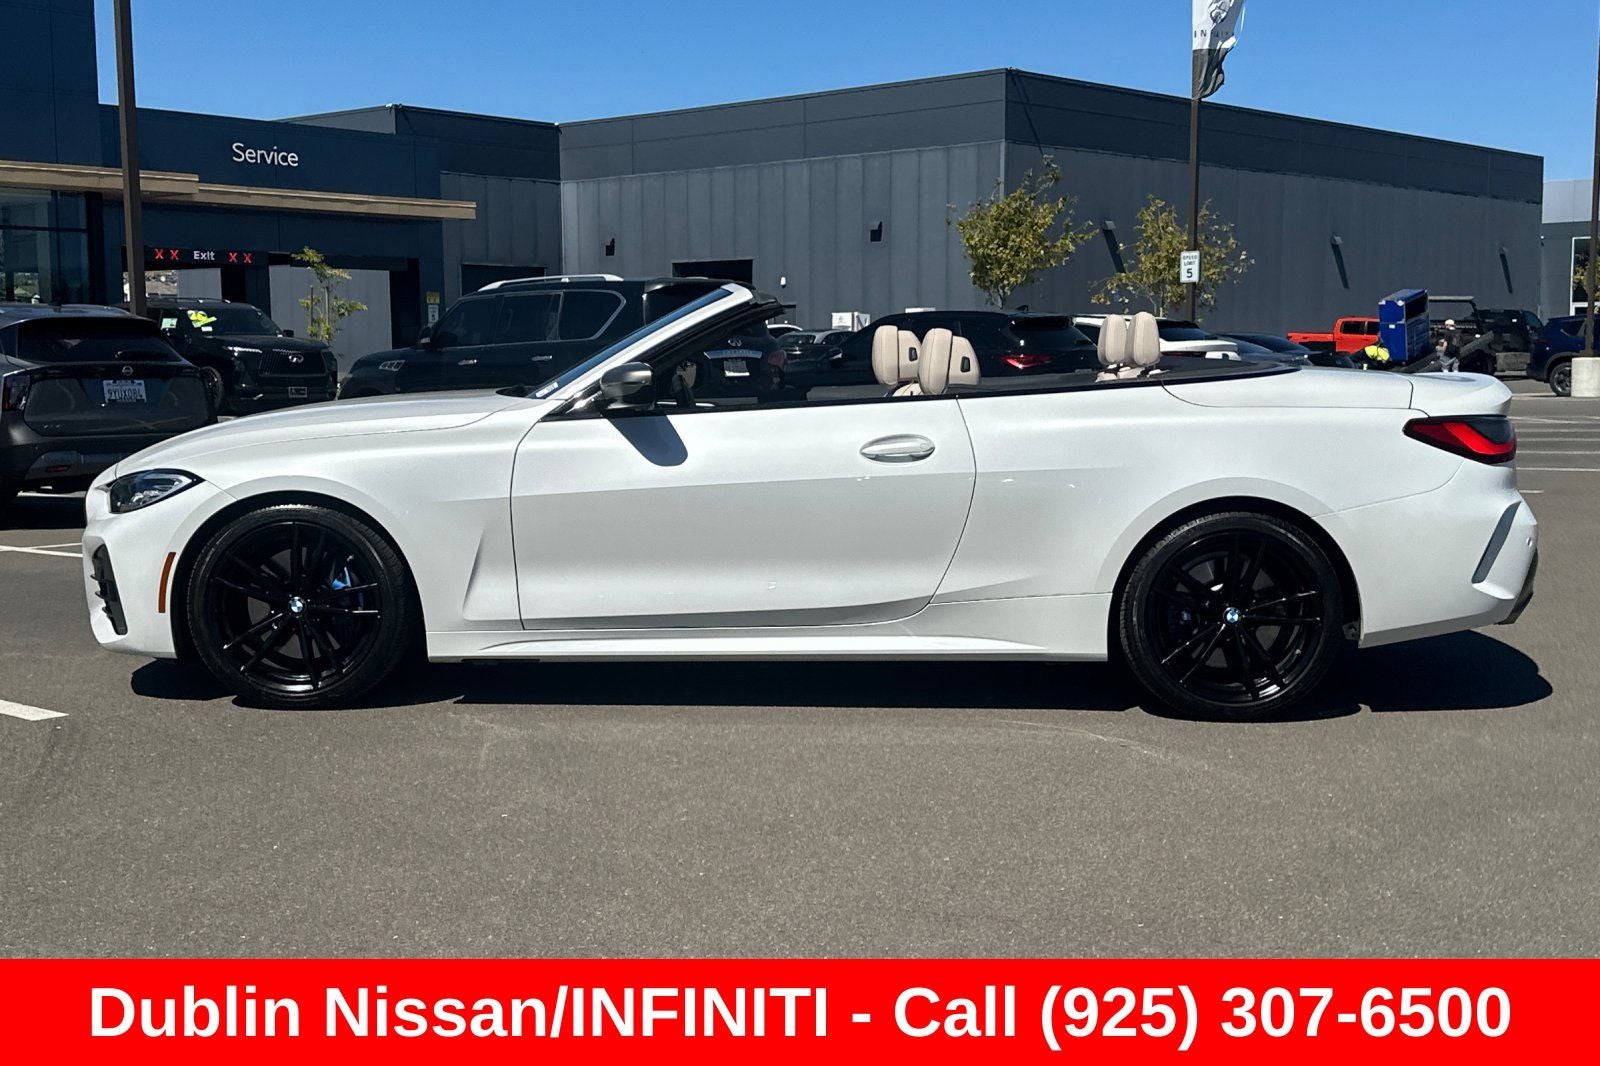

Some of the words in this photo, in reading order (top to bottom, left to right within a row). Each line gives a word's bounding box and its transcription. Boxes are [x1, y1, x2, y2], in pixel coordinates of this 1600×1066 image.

[232, 142, 299, 167] Service
[193, 250, 216, 261] Exit
[1186, 268, 1193, 279] 5
